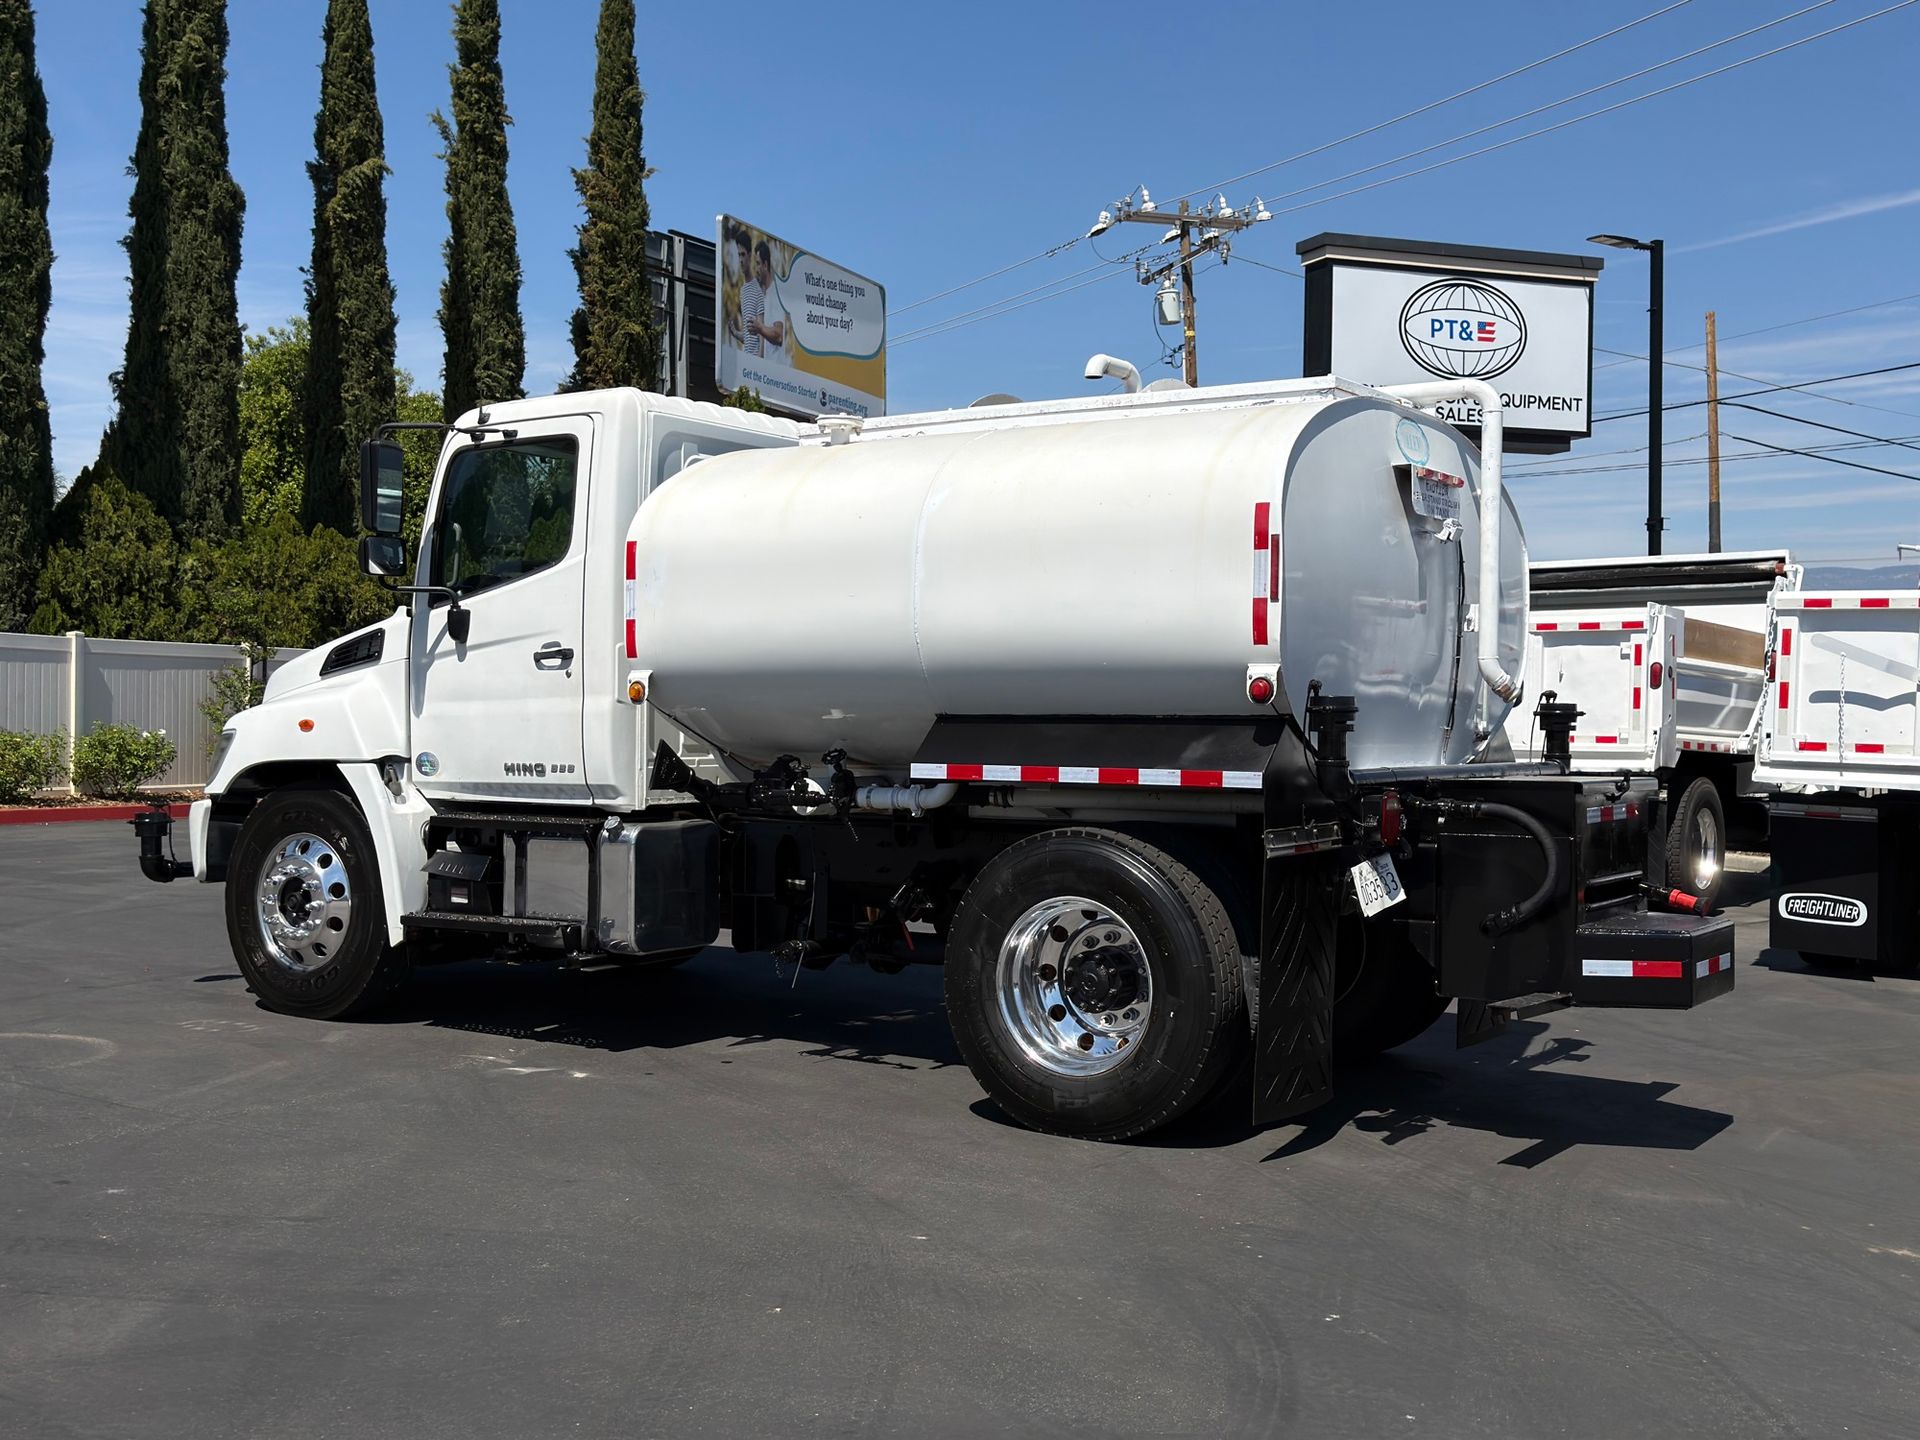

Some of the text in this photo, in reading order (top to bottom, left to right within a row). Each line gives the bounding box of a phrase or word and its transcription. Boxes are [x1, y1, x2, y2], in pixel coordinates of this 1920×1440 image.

[804, 271, 866, 299] What's one thing you
[805, 292, 847, 314] would change
[806, 309, 854, 333] about your day?
[742, 367, 818, 399] Get the Conversation Started
[828, 393, 869, 418] parenting.org
[1499, 392, 1583, 412] QUIPMENT
[1435, 406, 1483, 423] SALES
[503, 762, 547, 778] HINO
[1787, 898, 1859, 920] FREIGHTLINER
